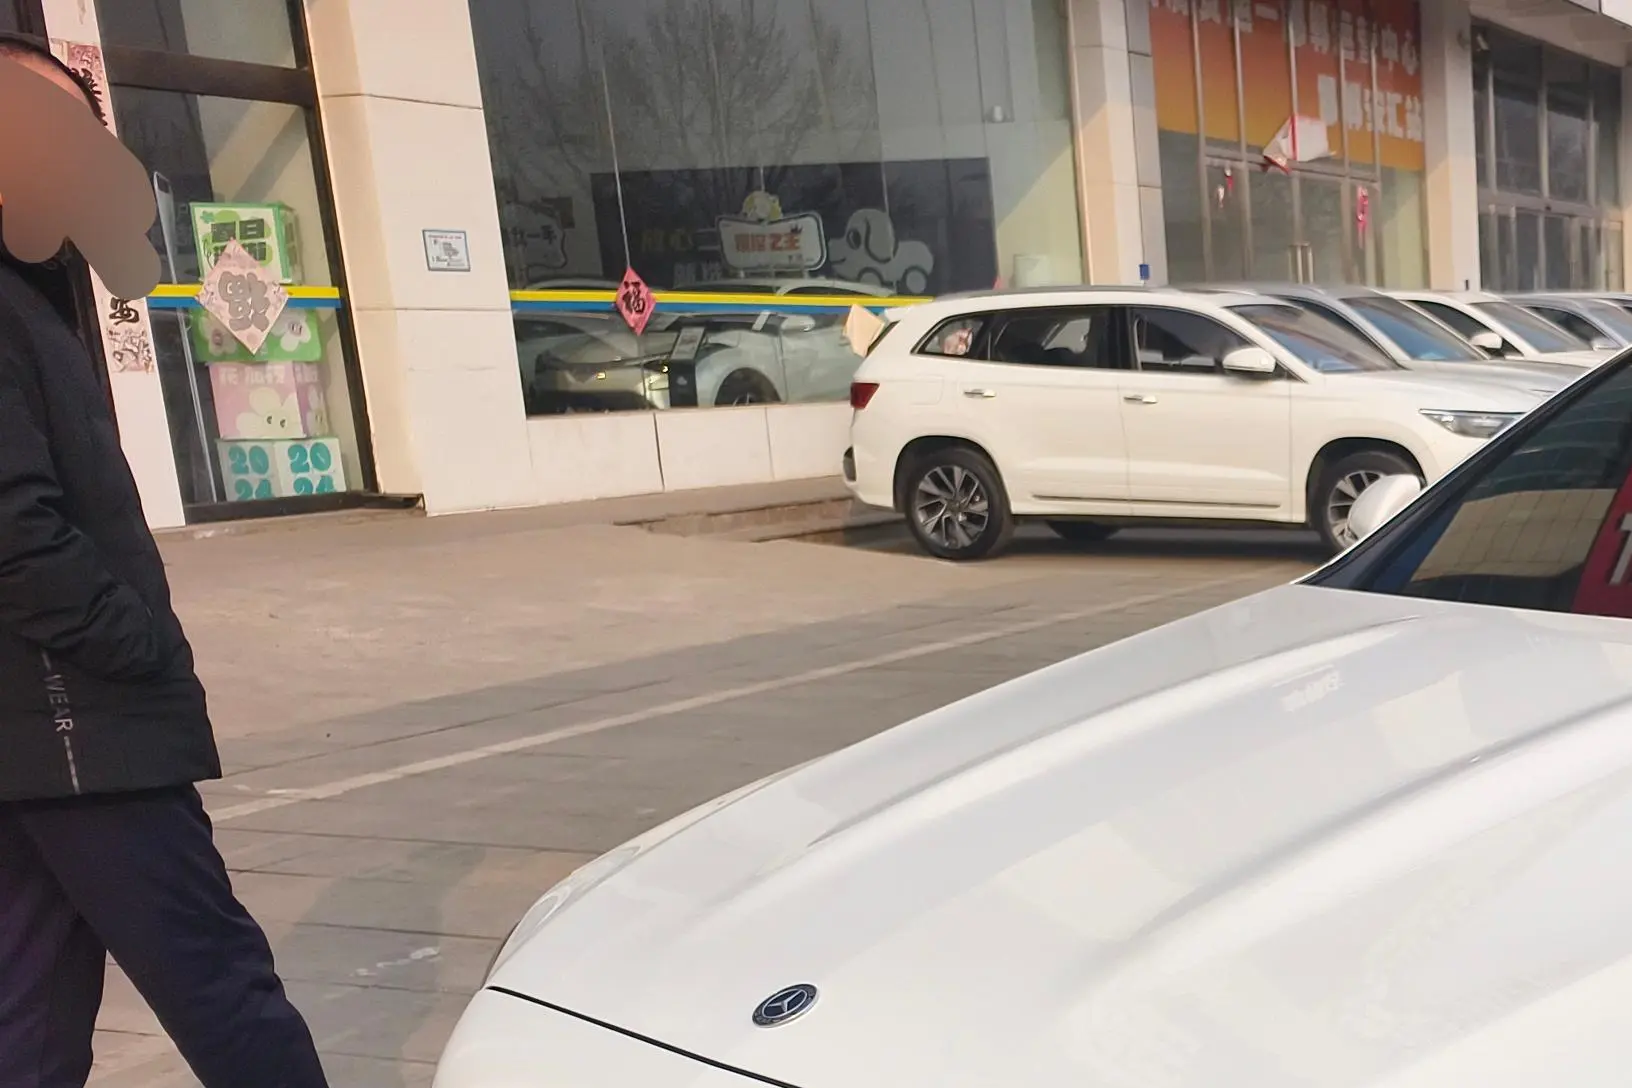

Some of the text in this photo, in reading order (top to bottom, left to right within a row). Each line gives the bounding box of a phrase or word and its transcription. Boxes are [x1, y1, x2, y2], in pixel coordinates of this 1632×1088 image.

[622, 280, 647, 315] 福
[228, 444, 270, 475] 20
[287, 441, 332, 474] 20
[42, 674, 74, 733] WEAR
